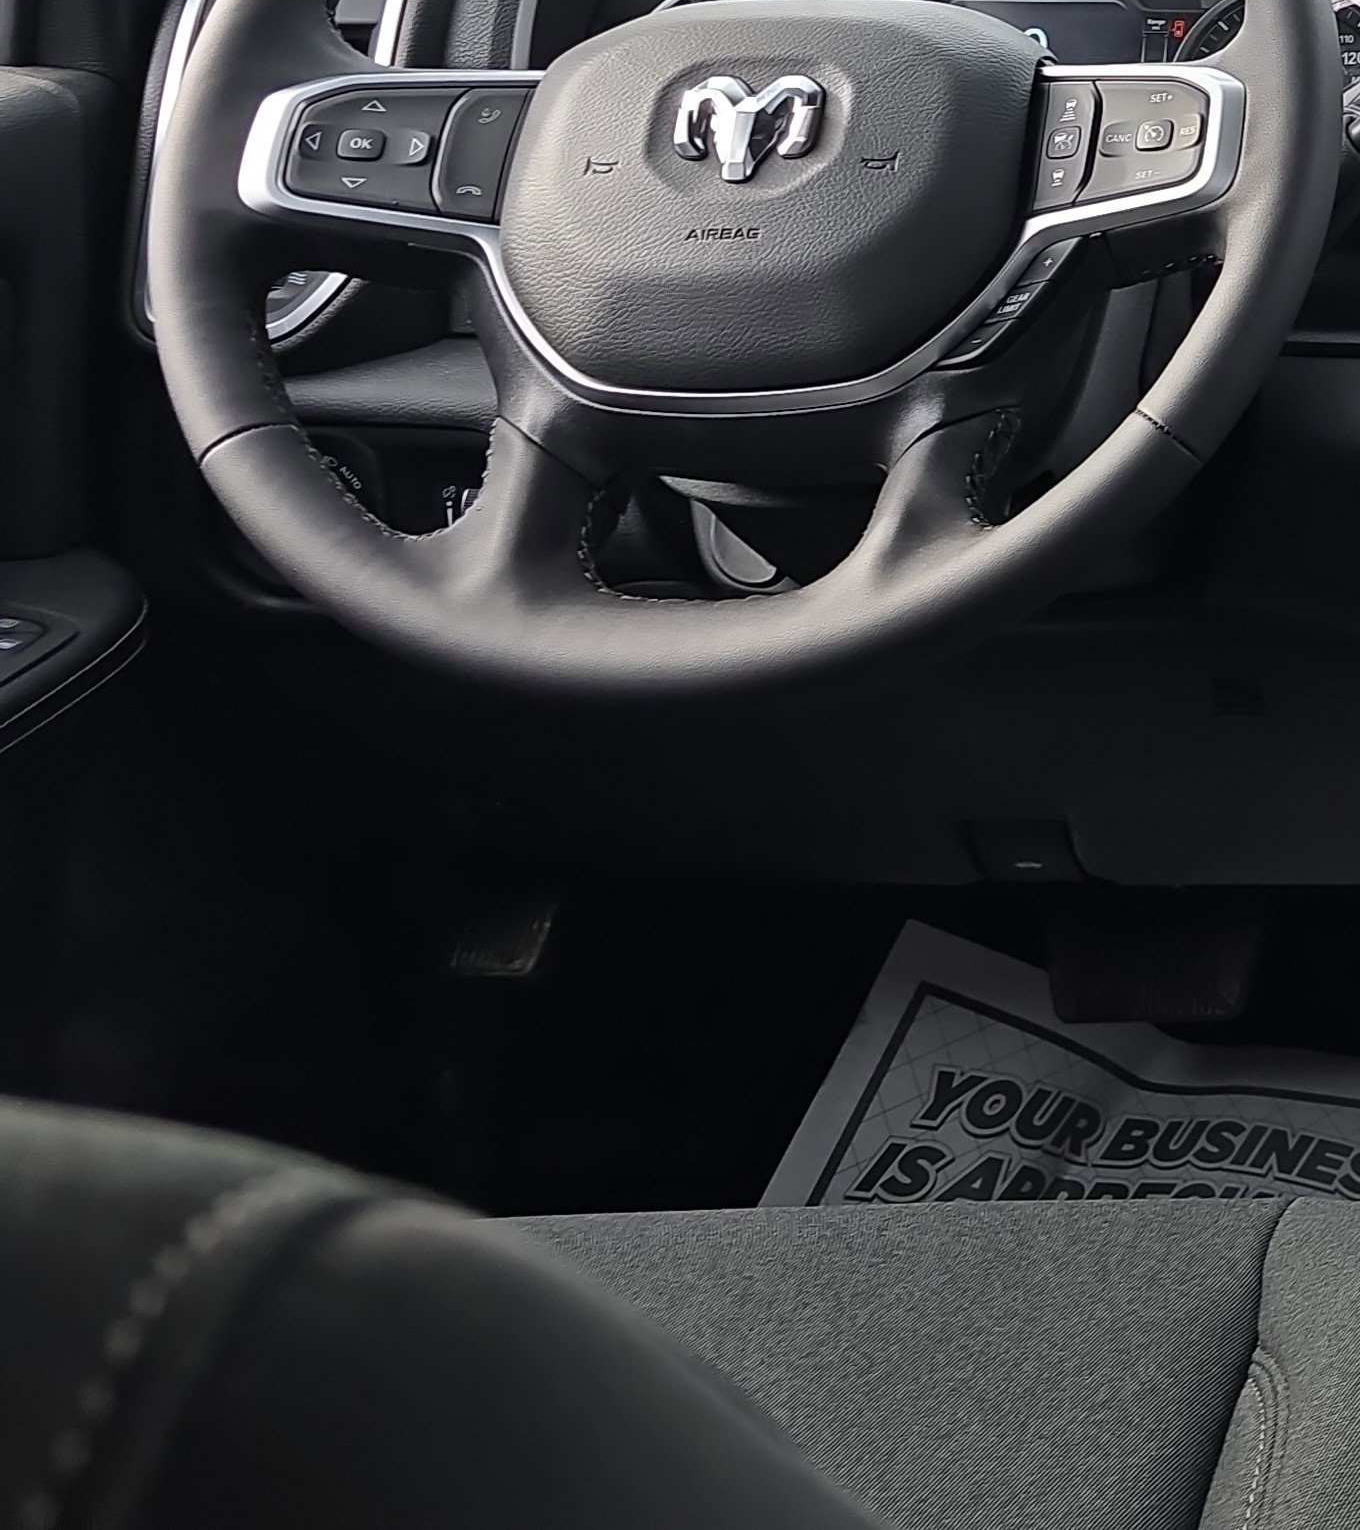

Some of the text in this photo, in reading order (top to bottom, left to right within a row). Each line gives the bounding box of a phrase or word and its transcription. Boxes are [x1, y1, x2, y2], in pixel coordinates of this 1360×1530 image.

[1339, 35, 1355, 44] 110
[1179, 124, 1197, 137] RES
[350, 136, 373, 151] OK
[1105, 132, 1132, 144] CANC
[684, 226, 762, 242] AIRBAG
[1006, 292, 1031, 303] GEAR
[997, 304, 1023, 315] LIMIT
[340, 466, 362, 490] AUTO
[917, 1068, 1104, 1158] YOUR
[858, 1141, 952, 1198] IS
